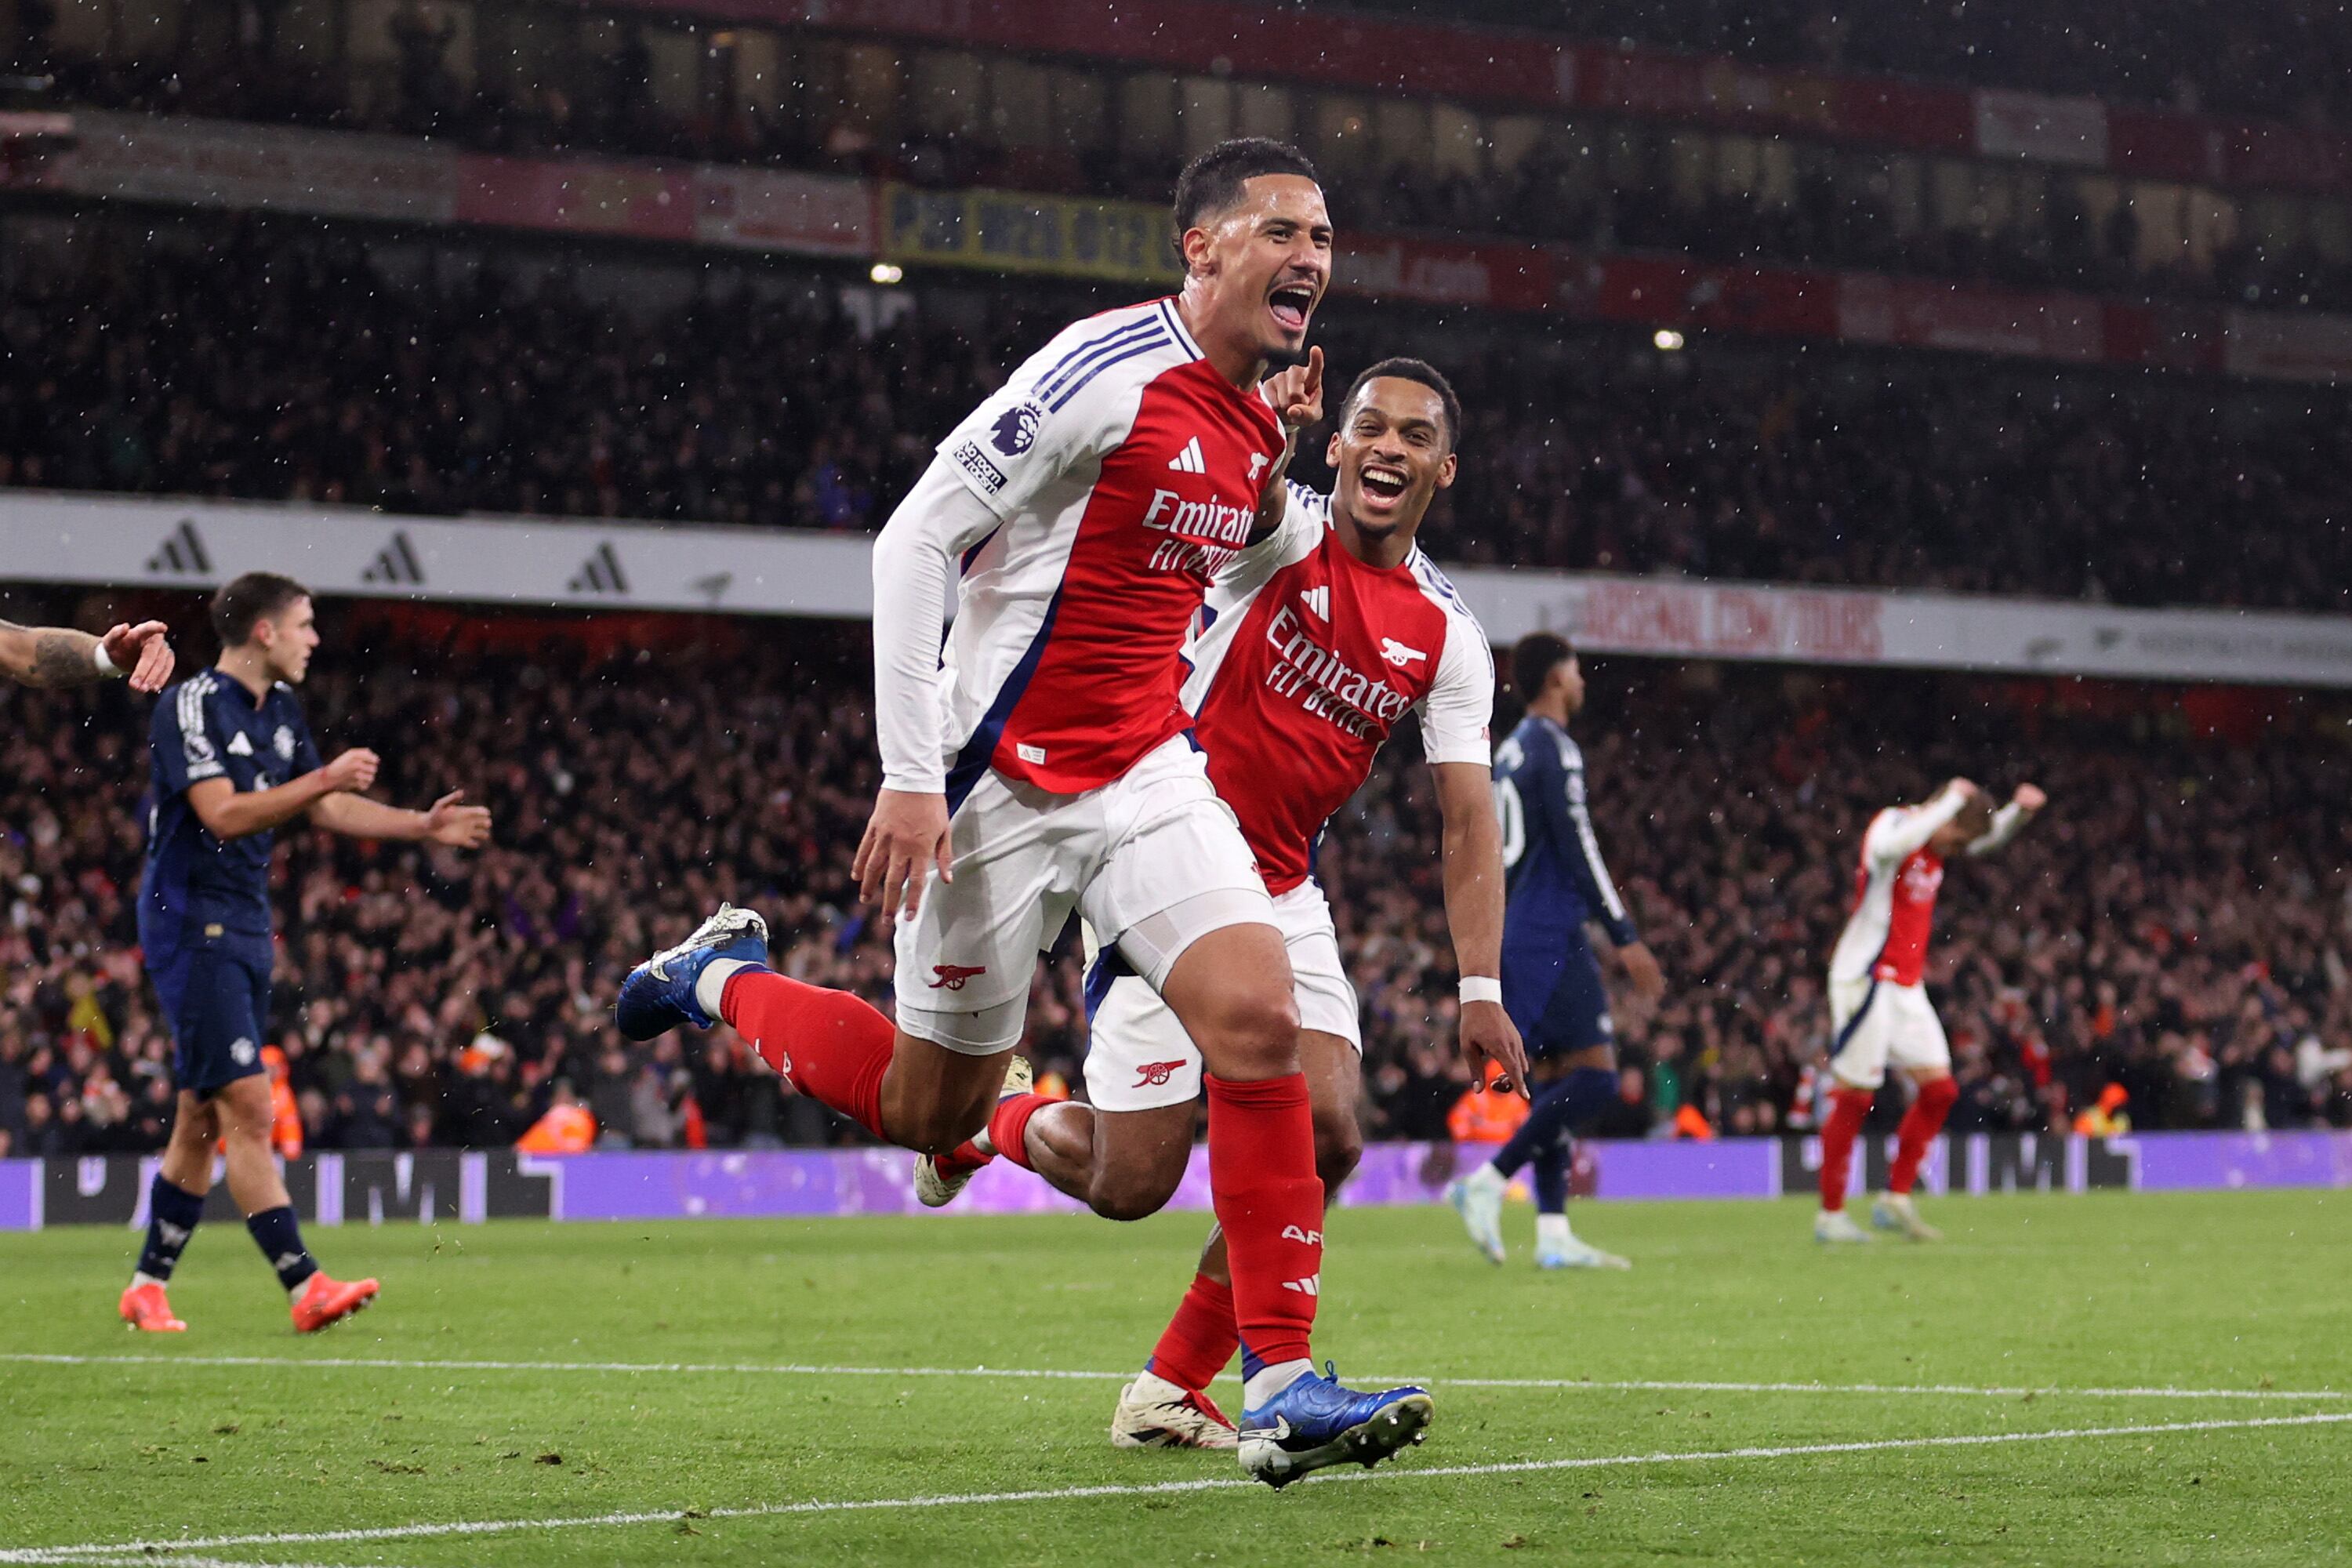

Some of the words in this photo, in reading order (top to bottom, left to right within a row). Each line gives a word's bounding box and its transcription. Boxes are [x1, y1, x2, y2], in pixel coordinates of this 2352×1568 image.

[953, 448, 971, 463] for
[960, 439, 977, 458] No
[974, 454, 1001, 485] room
[1142, 488, 1254, 545] Emirat
[1148, 539, 1195, 571] FLY
[1266, 603, 1410, 721] Emirates
[1265, 660, 1313, 699] FLY
[1301, 686, 1379, 740] BETTER
